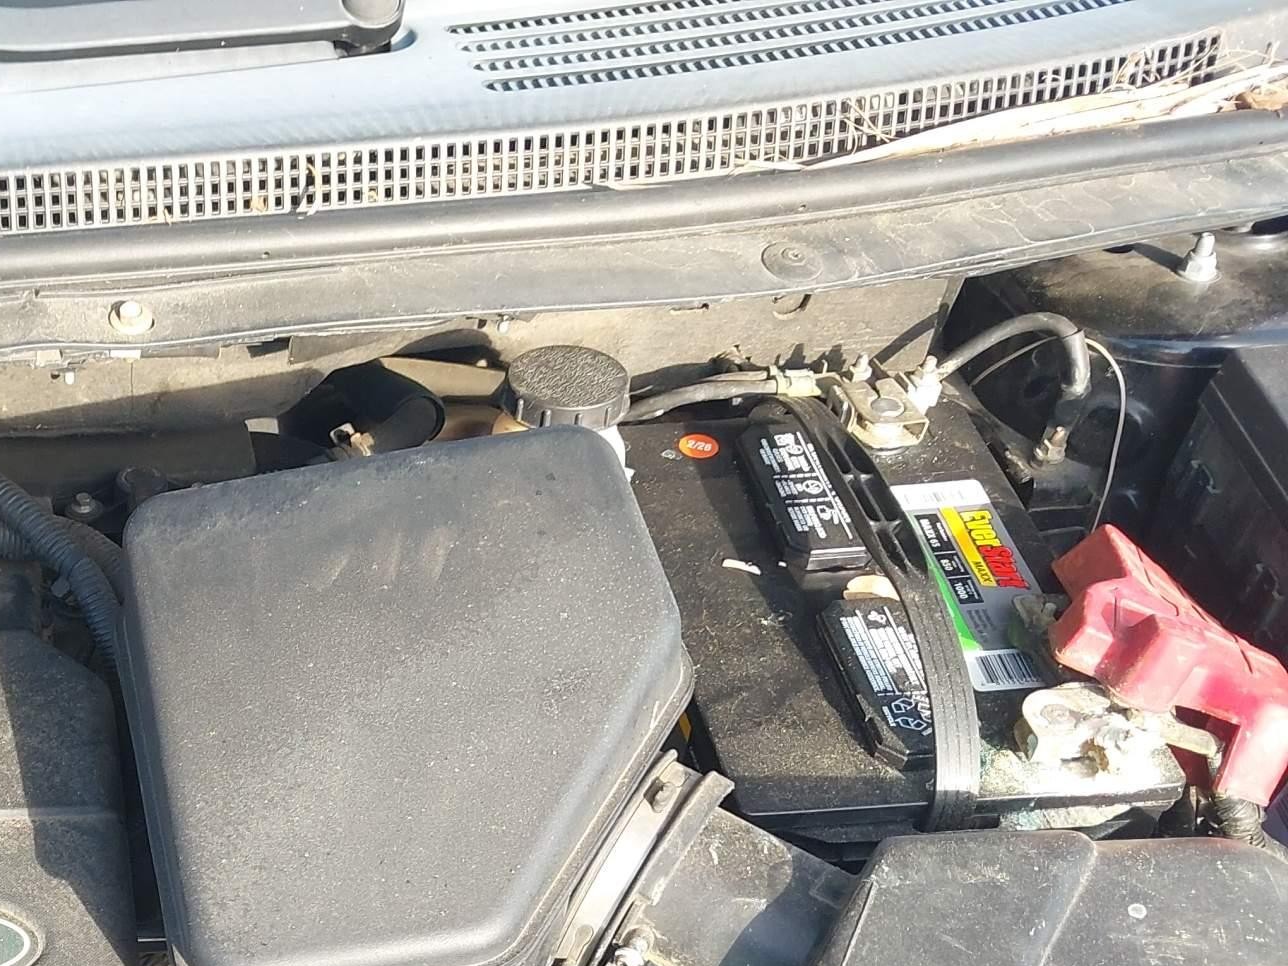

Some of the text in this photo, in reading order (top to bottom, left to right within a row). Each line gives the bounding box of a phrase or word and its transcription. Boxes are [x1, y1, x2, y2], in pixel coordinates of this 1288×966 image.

[959, 510, 1029, 590] EverStart
[972, 560, 993, 583] MAXX
[953, 582, 969, 600] 1000
